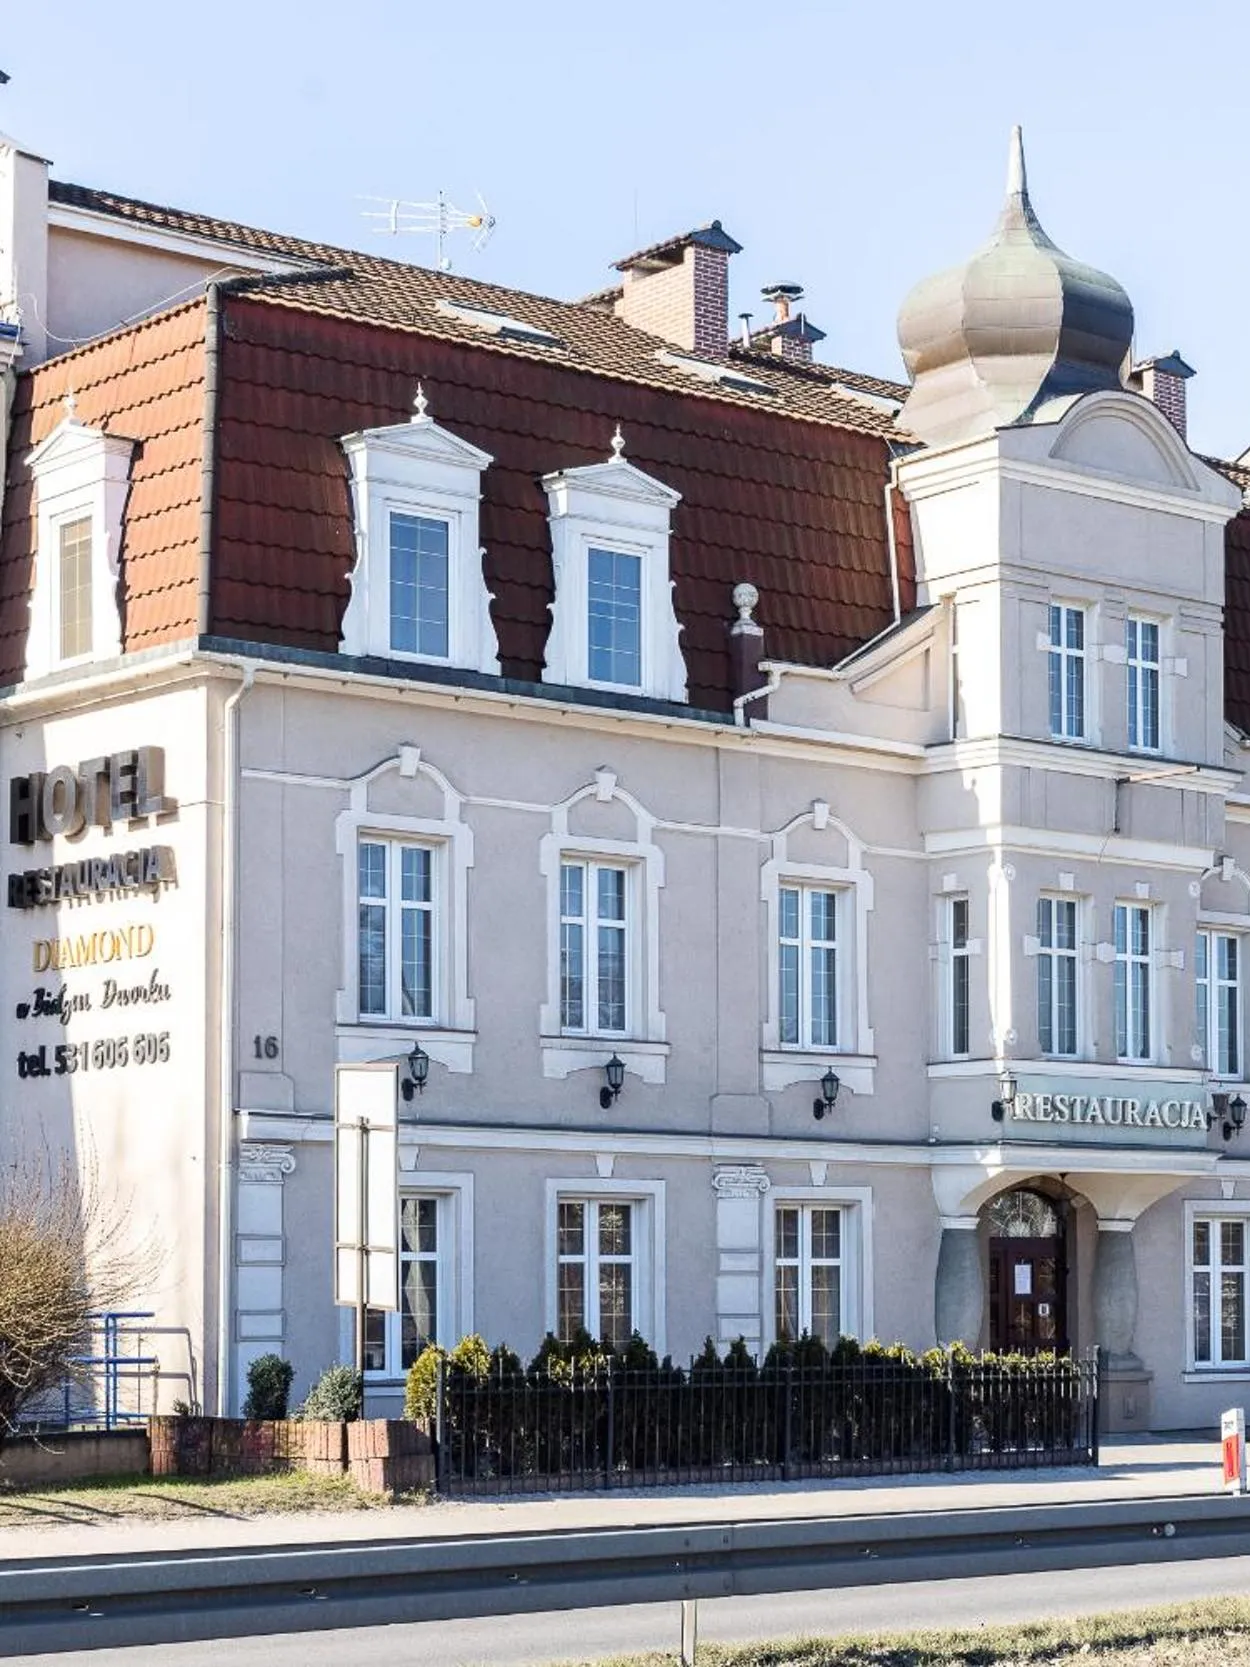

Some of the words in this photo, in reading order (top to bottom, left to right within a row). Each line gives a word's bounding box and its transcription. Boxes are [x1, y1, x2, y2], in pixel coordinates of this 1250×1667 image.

[10, 745, 179, 845] HOTEL
[7, 845, 179, 909] RESTAURACJA
[33, 924, 156, 973] DIAMOND
[54, 1041, 89, 1075] 531
[92, 1035, 129, 1070] 606
[133, 1030, 171, 1066] 606
[253, 1035, 280, 1060] 16
[1013, 1092, 1208, 1131] RESTAURACJA
